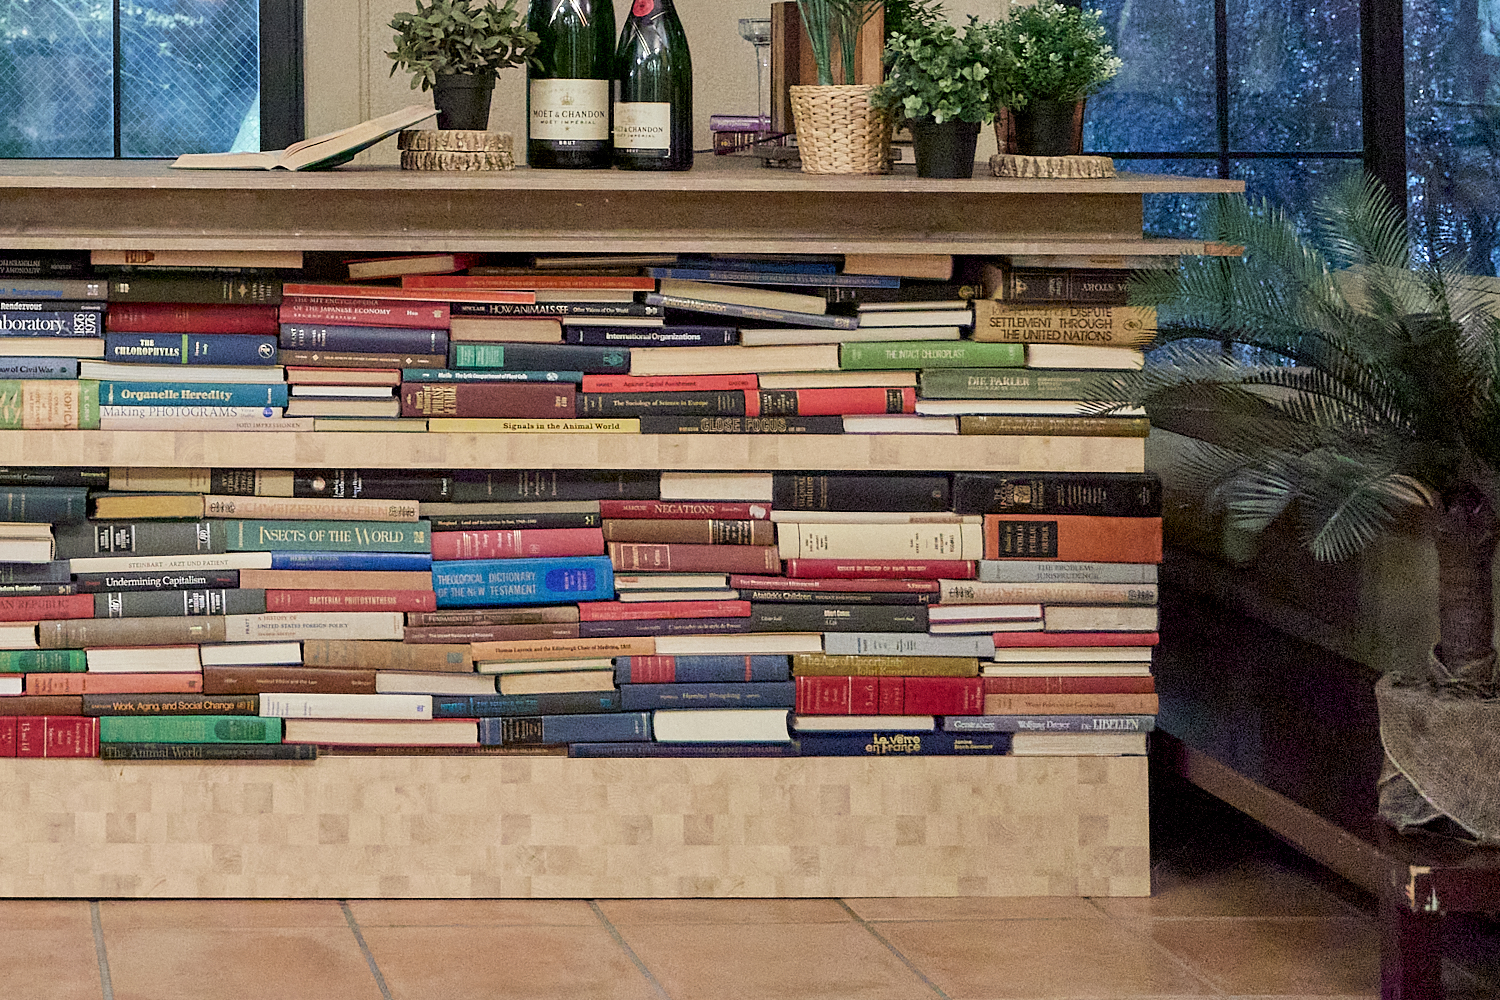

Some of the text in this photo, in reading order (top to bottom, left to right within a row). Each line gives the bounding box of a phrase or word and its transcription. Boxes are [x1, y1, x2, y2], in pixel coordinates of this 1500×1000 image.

[1, 302, 43, 310] Rendezvous
[74, 313, 84, 336] 1876
[85, 313, 97, 336] 1976
[990, 317, 1113, 329] SETTLEMENT THROUGH
[652, 332, 701, 341] Organizations
[1001, 329, 1113, 341] THE UNITED NATIONS
[114, 346, 180, 357] CHLOROPHYLLS
[897, 349, 966, 359] INTACT CHLOROPLAST
[20, 364, 38, 373] Civil
[38, 365, 54, 373] War
[121, 389, 233, 402] Organelle Heredity
[103, 406, 238, 419] Making PHOTOGRAMS
[503, 422, 534, 431] Signals
[700, 417, 787, 433] CLOSE FOCUS
[654, 504, 715, 514] NEGATIONS
[260, 526, 404, 545] INSECTS OF THE WORLD
[128, 561, 163, 569] STEINBART
[106, 576, 207, 587] Undermining Capitalism
[437, 572, 536, 585] THEOLOGICAL DICTIONARY
[490, 584, 536, 596] TESTAMENT
[113, 701, 235, 712] Work, Aging, and Social Change
[1093, 718, 1139, 730] LIBELLEN
